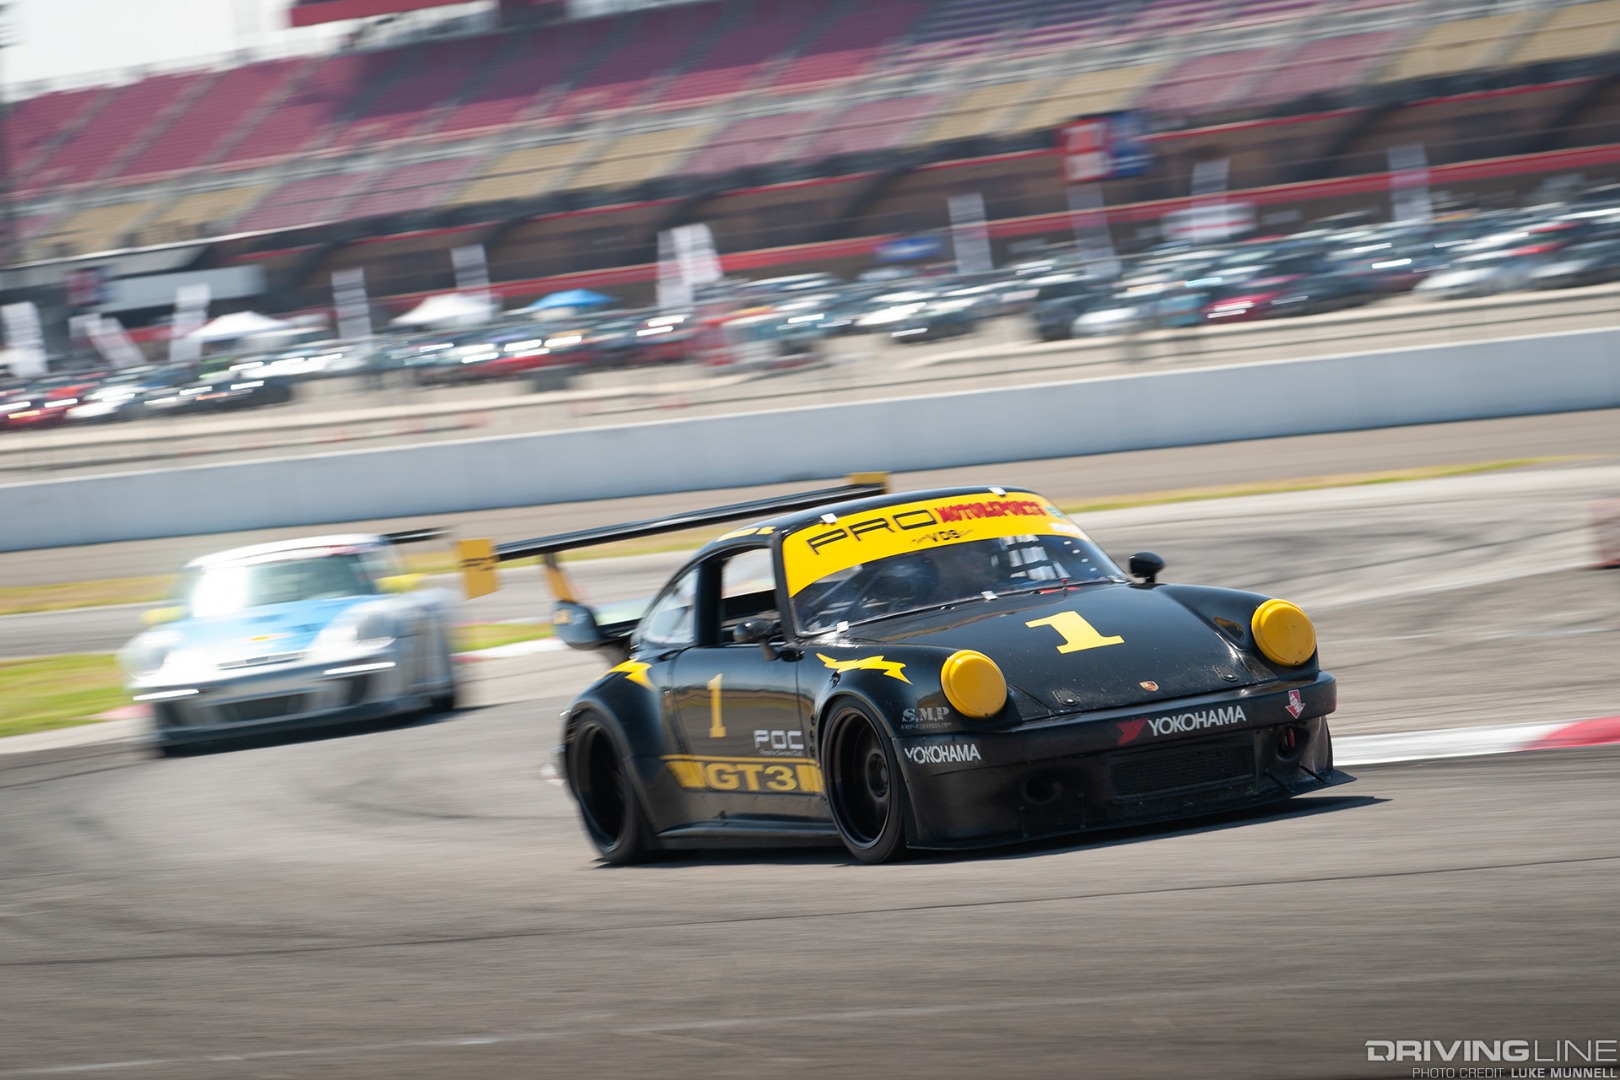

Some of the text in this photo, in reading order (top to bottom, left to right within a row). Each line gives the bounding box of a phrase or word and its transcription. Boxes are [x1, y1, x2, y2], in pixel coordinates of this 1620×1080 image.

[806, 509, 938, 556] PRO
[1025, 610, 1125, 655] 1
[706, 673, 727, 738] 1
[1148, 705, 1247, 737] YOKOHAMA
[753, 729, 805, 750] POC
[904, 743, 982, 765] YOKOHAMA
[705, 763, 798, 791] GT3
